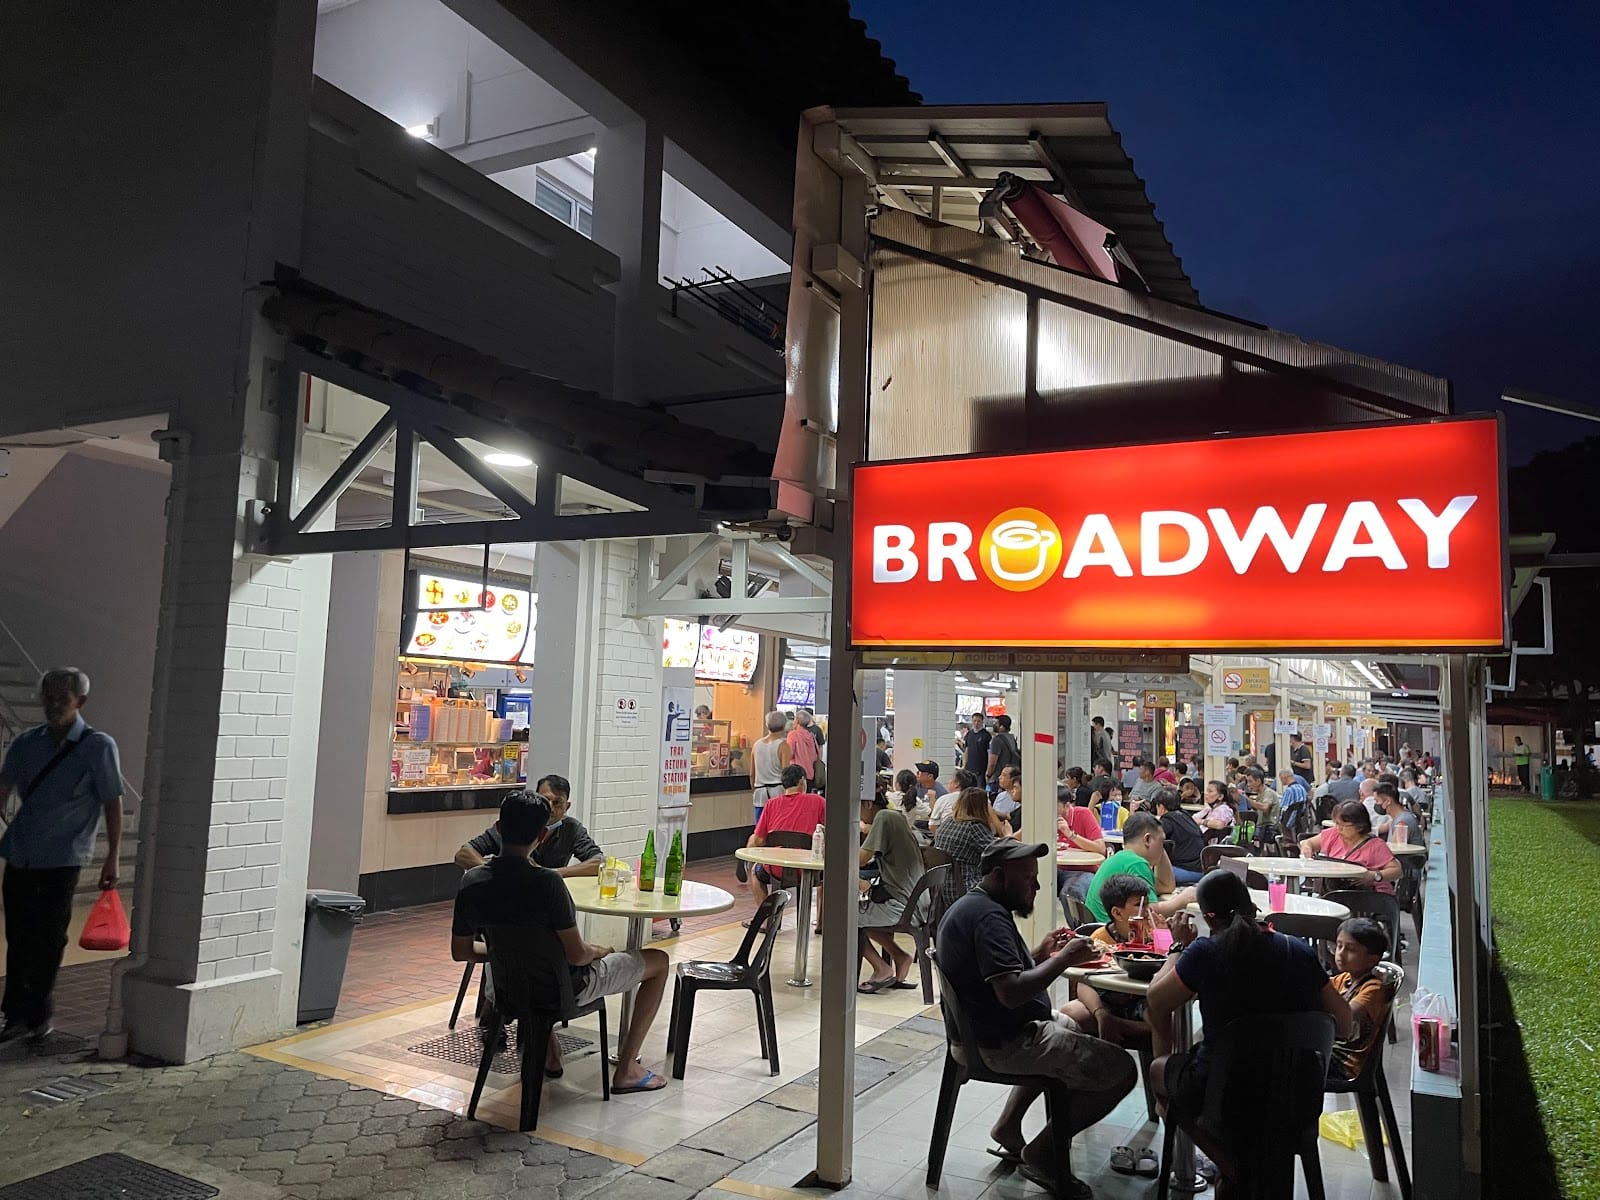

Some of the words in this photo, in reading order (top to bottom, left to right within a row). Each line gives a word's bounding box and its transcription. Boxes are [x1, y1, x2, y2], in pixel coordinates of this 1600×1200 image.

[872, 495, 1478, 592] BROADWAY
[670, 746, 684, 756] TRAY
[664, 759, 687, 770] RETURN
[663, 771, 688, 783] STATION
